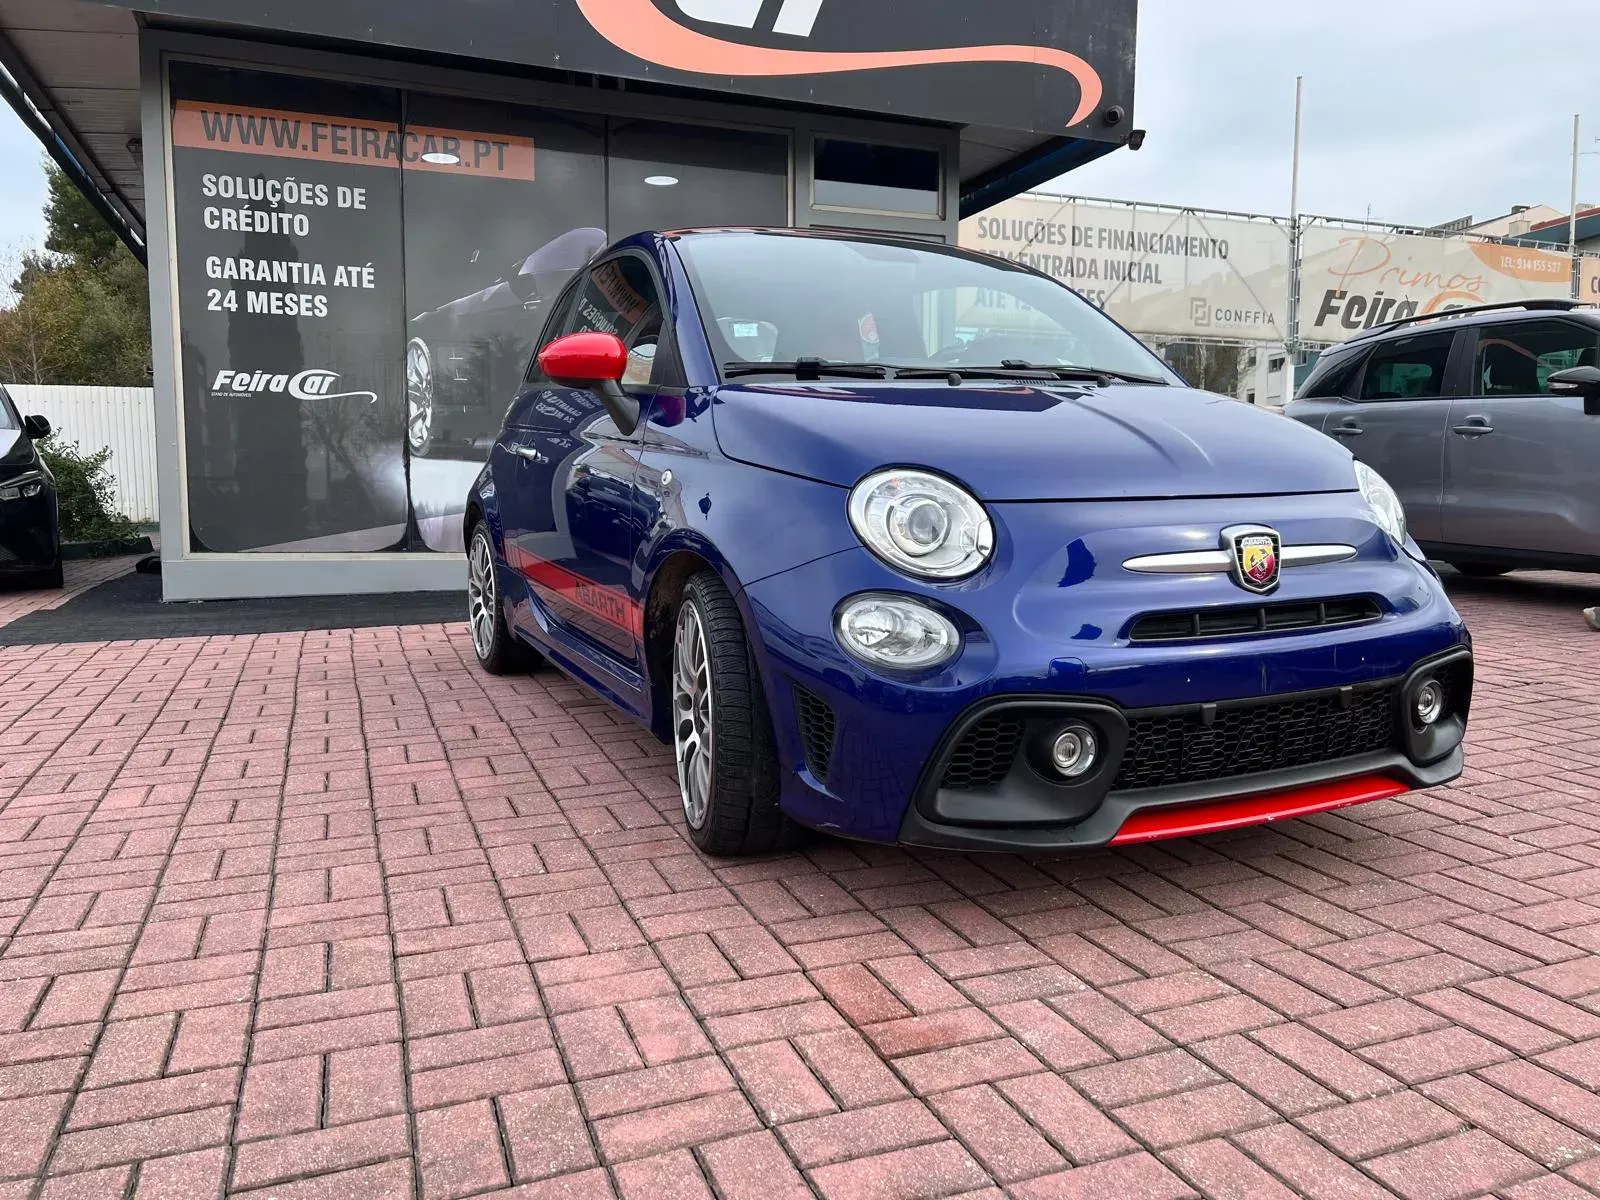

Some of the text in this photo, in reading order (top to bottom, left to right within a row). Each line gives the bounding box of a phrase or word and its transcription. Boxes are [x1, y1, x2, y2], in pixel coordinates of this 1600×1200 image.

[200, 109, 510, 171] WWW.FEIRACAR.PT
[201, 173, 367, 210] SOLUÇÕES DE
[203, 204, 310, 237] CRÉDITO
[1071, 225, 1094, 248] DE
[1098, 228, 1229, 260] FINANCIAMENTO
[205, 256, 376, 289] GARANTIA ATÉ
[1103, 259, 1163, 285] INICIAL
[206, 288, 329, 318] 24 MESES
[1215, 308, 1276, 326] CONFFIA
